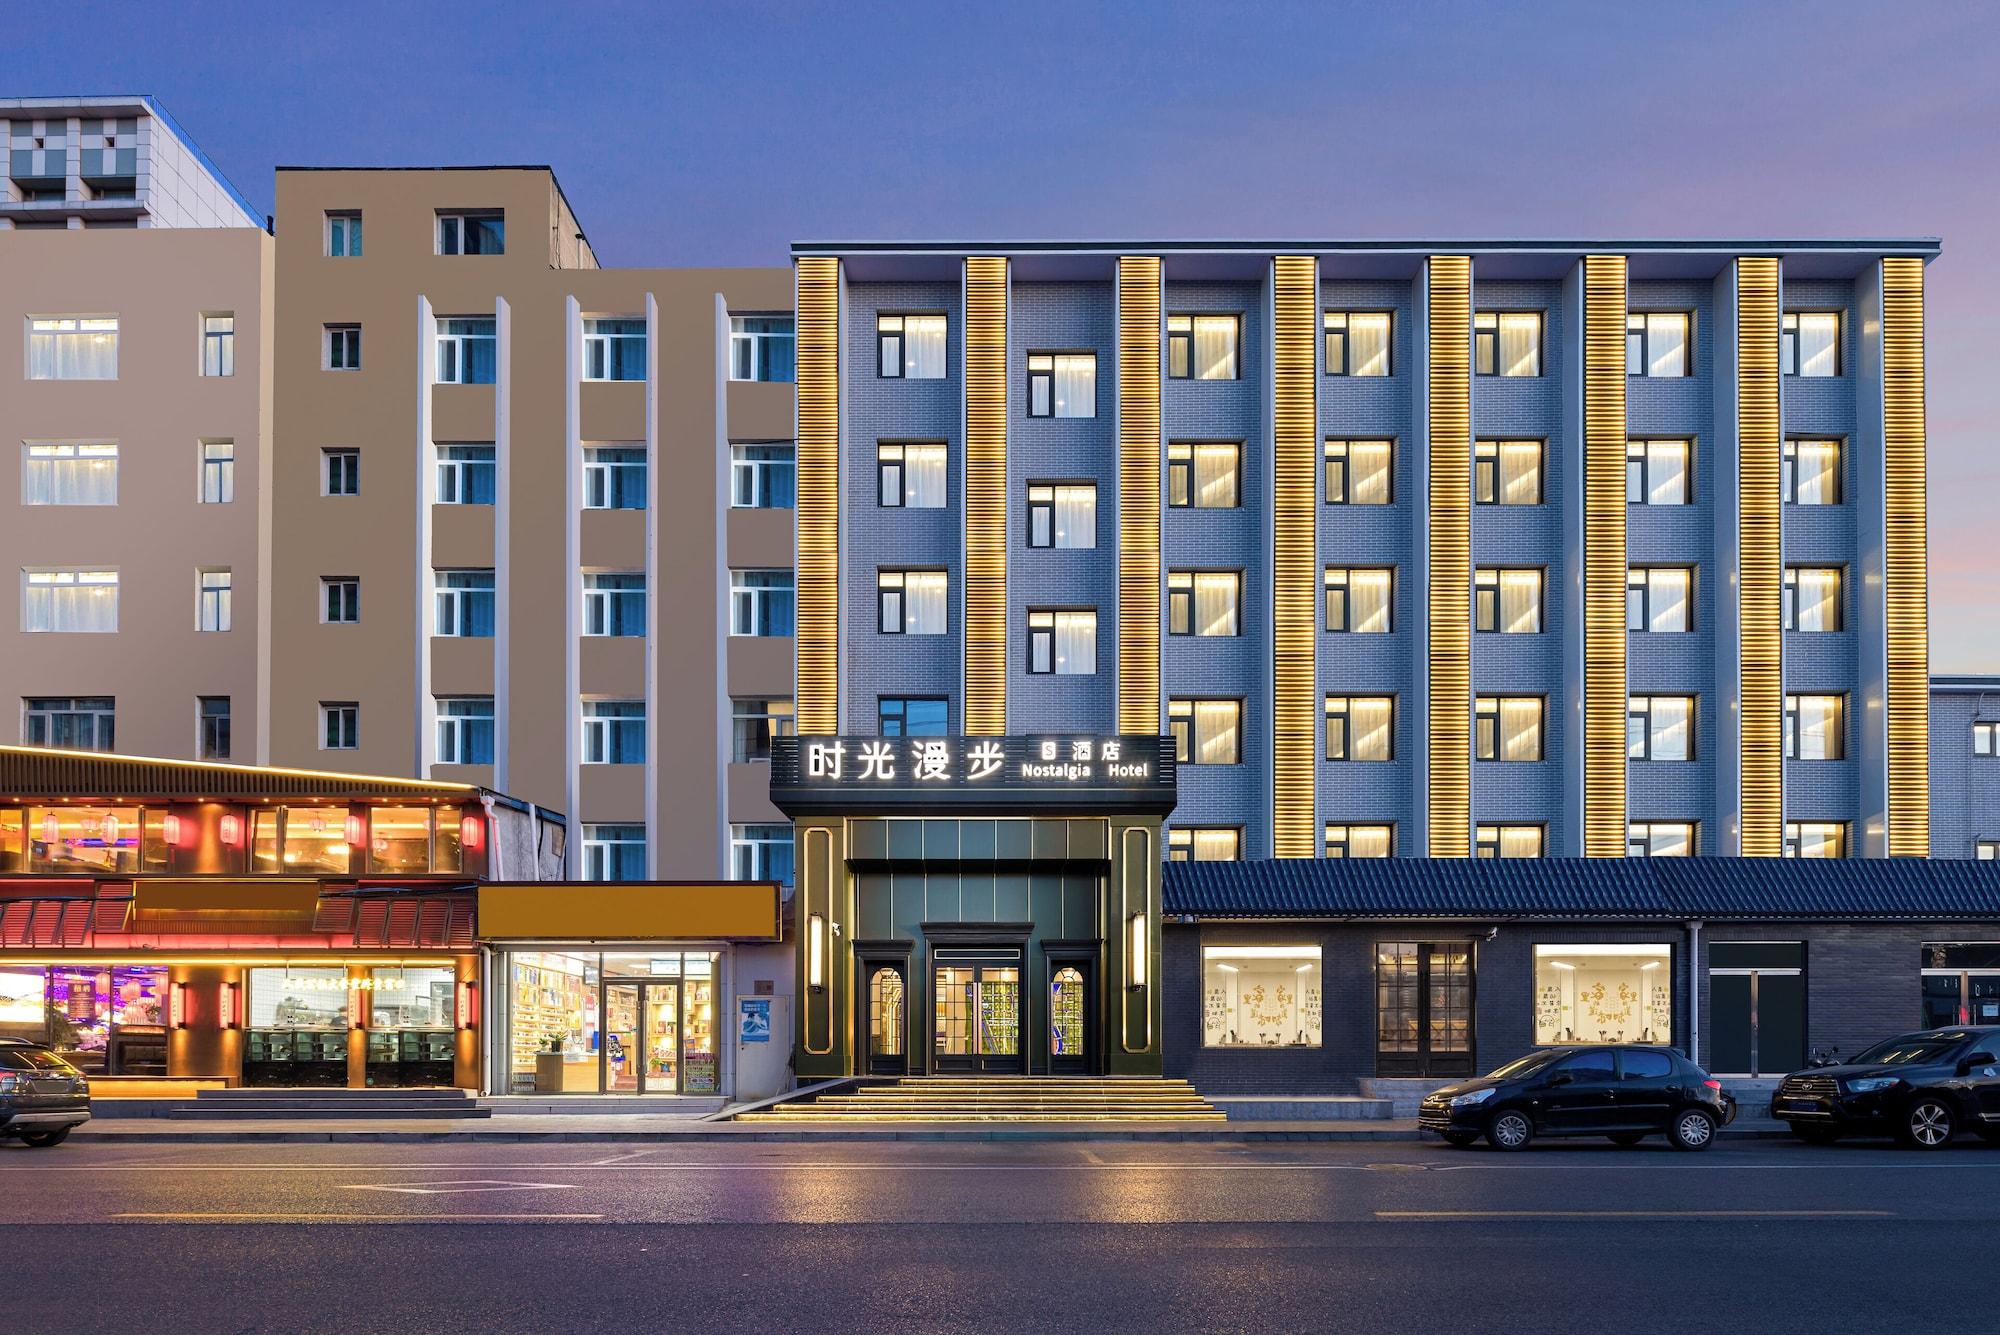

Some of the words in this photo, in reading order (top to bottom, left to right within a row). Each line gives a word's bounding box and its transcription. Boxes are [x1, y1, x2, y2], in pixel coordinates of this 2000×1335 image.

[808, 740, 1005, 780] 时光漫步
[1072, 741, 1120, 761] 酒店
[1022, 763, 1091, 780] Nostalgia
[1108, 763, 1148, 777] Hotel
